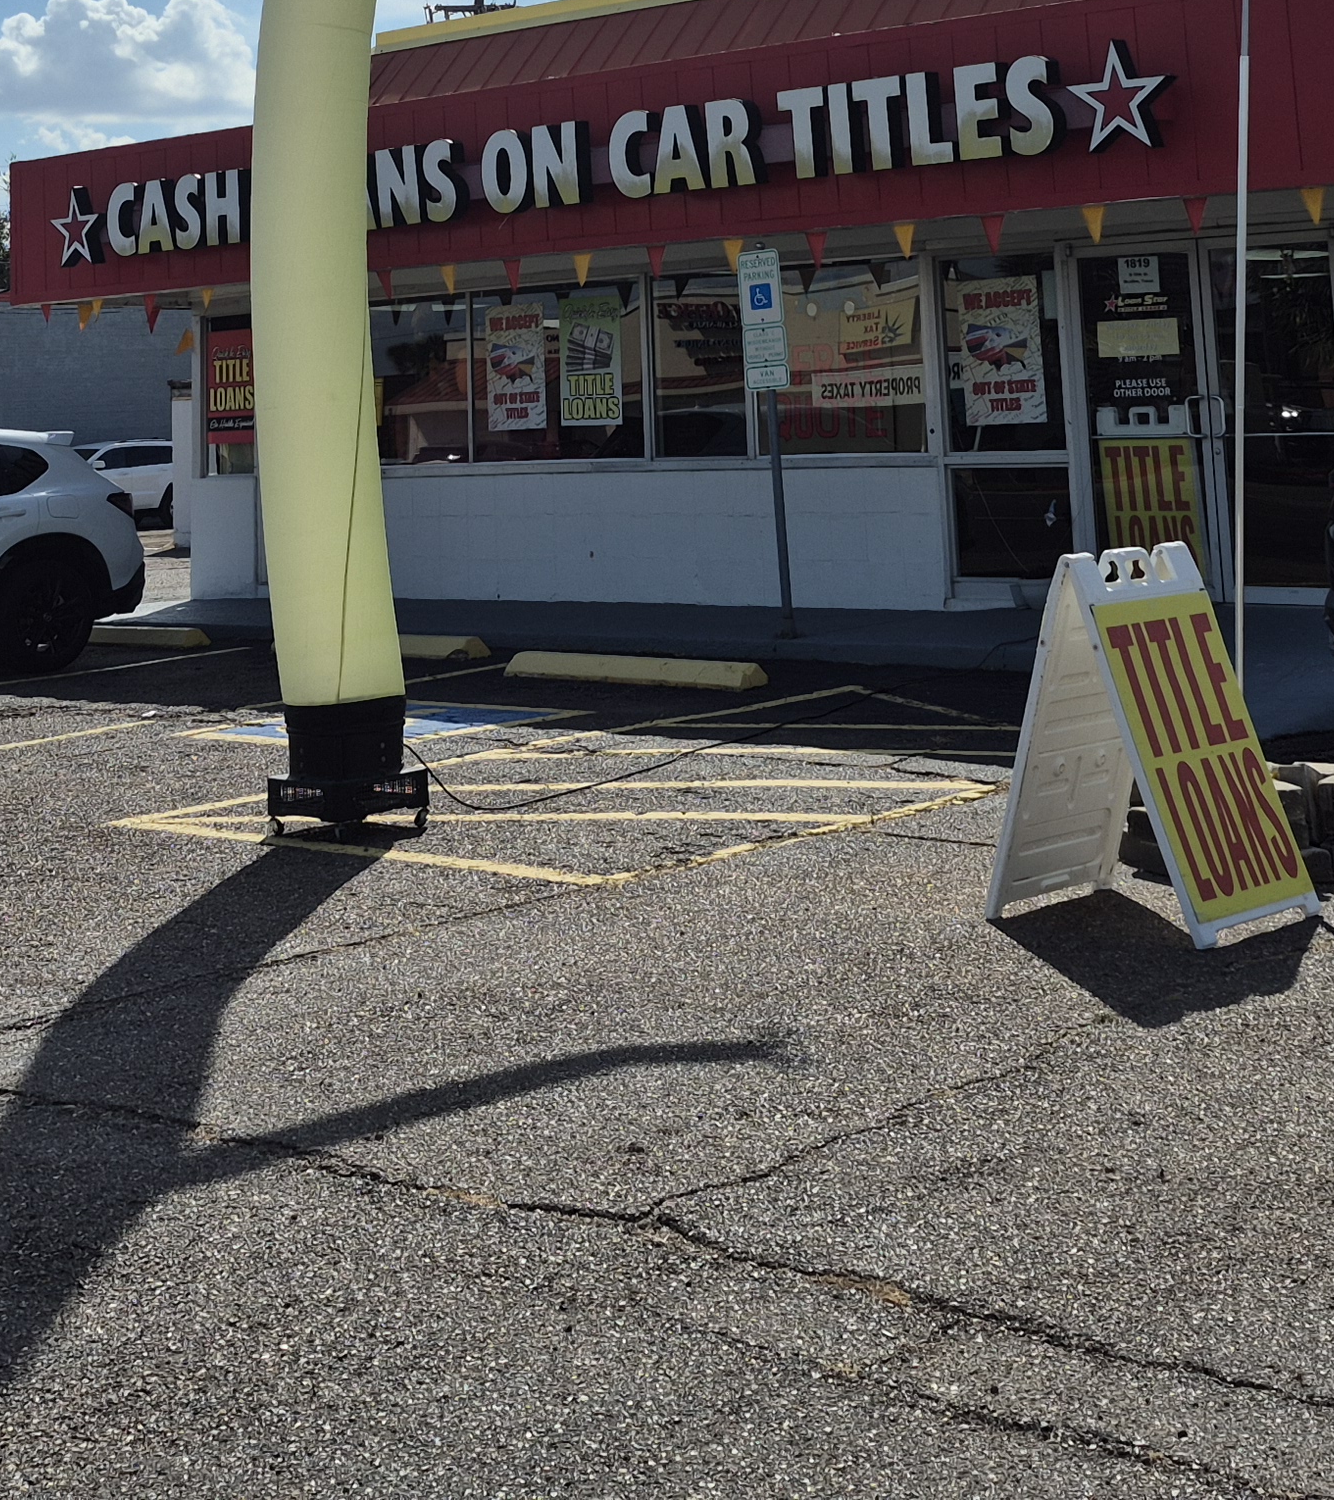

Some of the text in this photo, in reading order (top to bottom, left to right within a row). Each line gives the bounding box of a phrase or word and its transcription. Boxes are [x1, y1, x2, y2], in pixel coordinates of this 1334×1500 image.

[106, 169, 242, 257] CASH
[481, 120, 580, 214] ON
[609, 98, 760, 199] CAR
[777, 55, 1056, 180] TITLES
[741, 257, 776, 269] RESERVED
[1124, 258, 1150, 268] 1819
[744, 269, 775, 281] PARKING
[963, 289, 1032, 310] WE ACCEPT
[489, 313, 540, 332] WE ACCEPT
[213, 359, 250, 383] TITLE
[567, 373, 614, 396] TITLE
[972, 382, 992, 396] OUT
[994, 381, 1006, 394] OF
[1113, 387, 1171, 397] OTHER DOOR
[1115, 378, 1167, 388] PLEASE USE
[209, 385, 254, 412] LOANS
[563, 397, 620, 421] LOANS
[1104, 445, 1191, 511] TITLE
[1107, 612, 1249, 758] TITLE
[1155, 747, 1299, 902] LOANS
